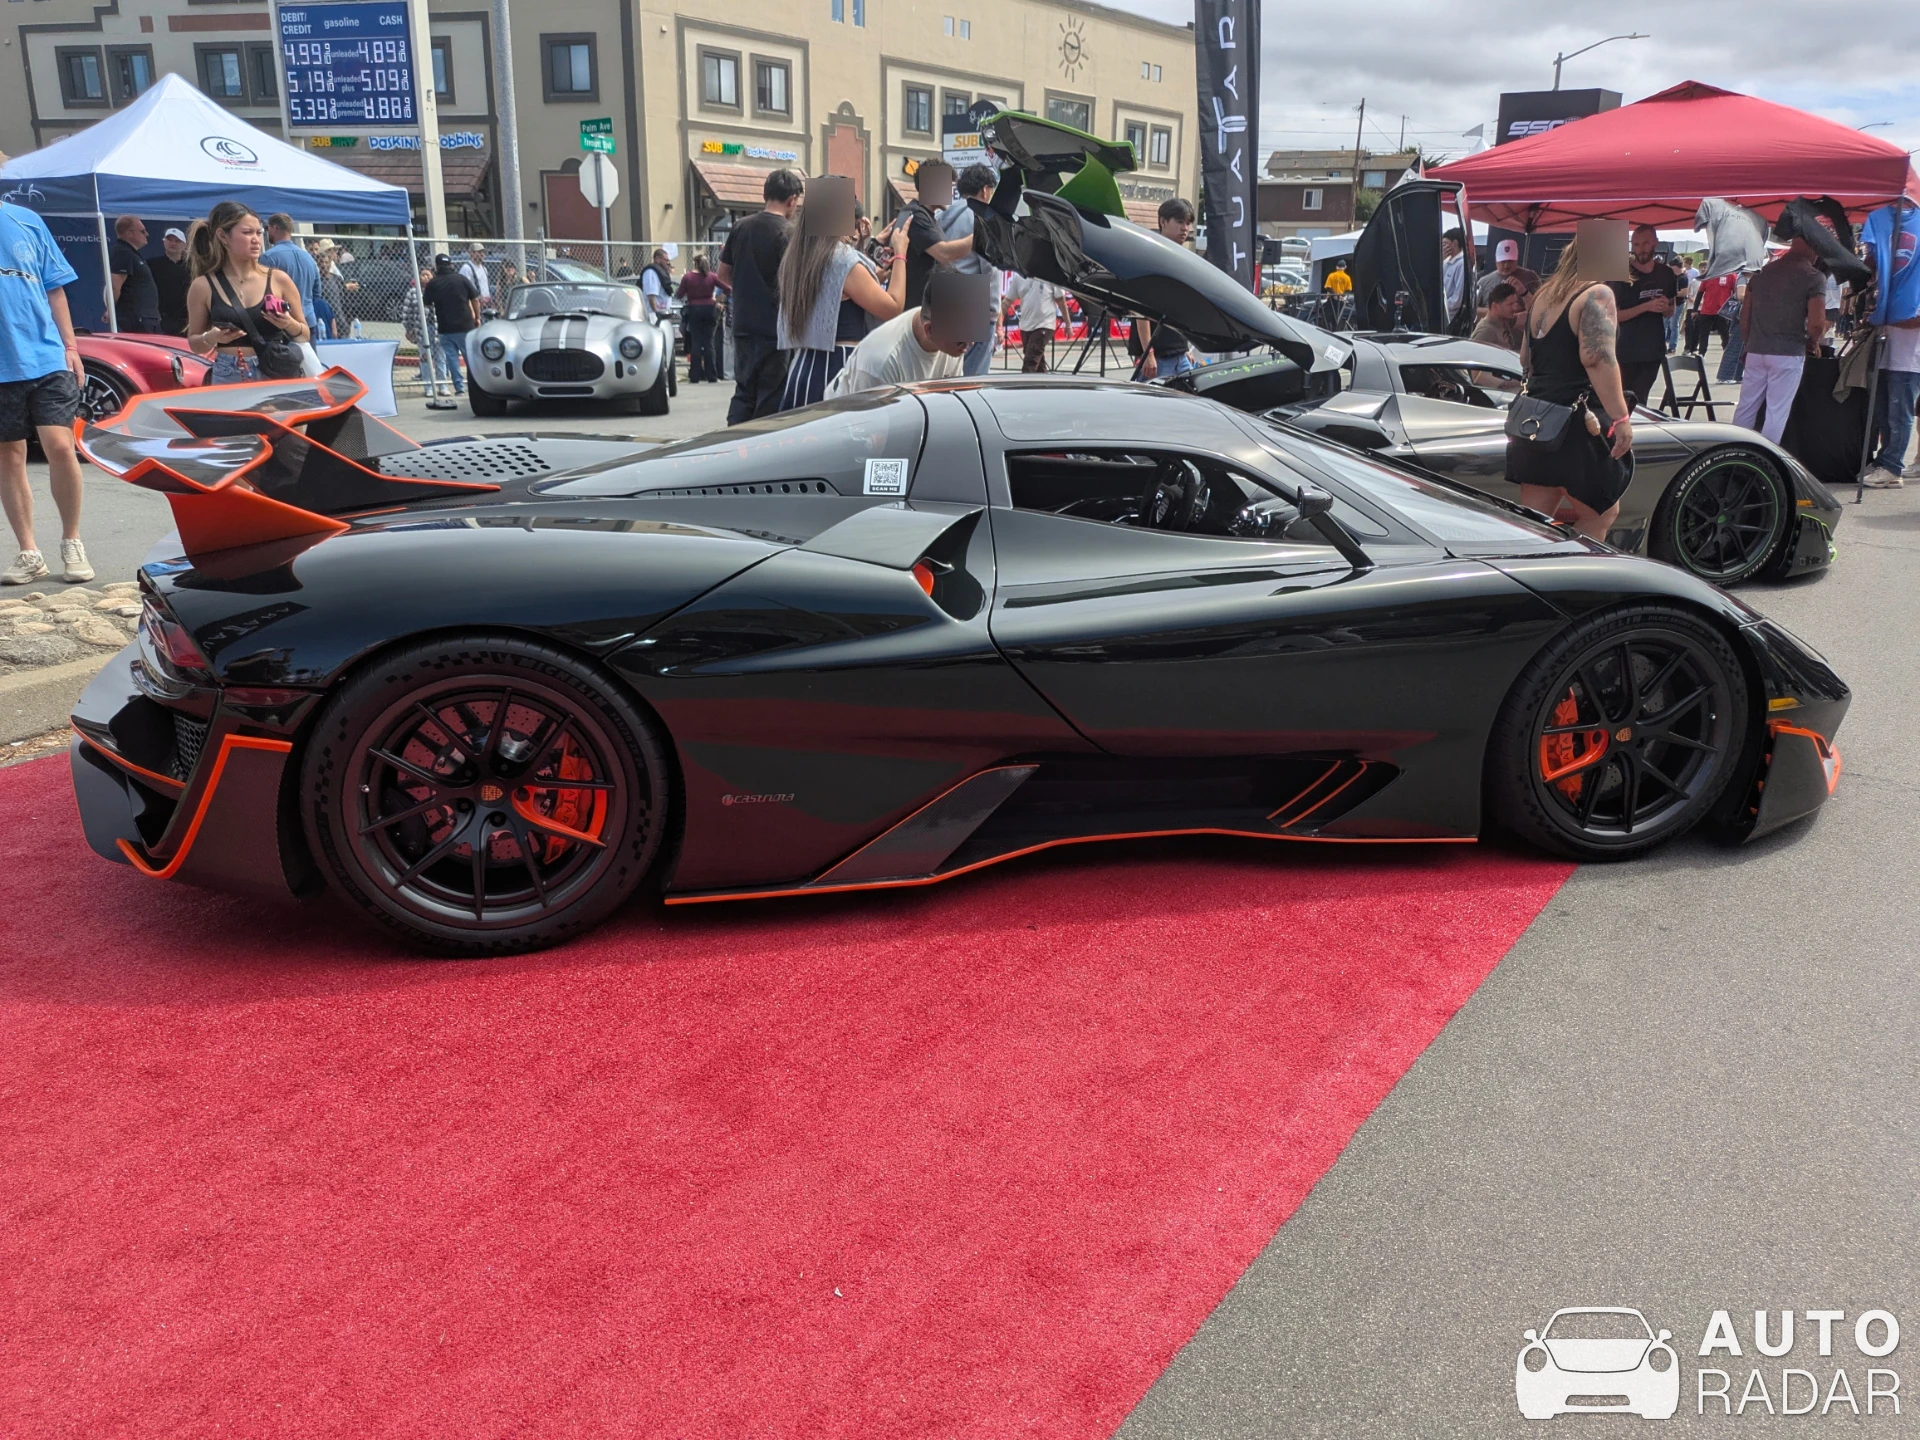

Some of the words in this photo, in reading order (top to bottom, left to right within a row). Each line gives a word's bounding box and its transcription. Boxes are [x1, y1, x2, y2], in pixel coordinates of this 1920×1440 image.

[281, 12, 307, 23] DEBIT/
[379, 15, 403, 26] CASH
[324, 17, 360, 30] gasoline
[282, 24, 312, 35] CREDIT
[330, 49, 360, 58] unleaded
[333, 74, 361, 83] unleaded
[341, 84, 355, 94] plus
[335, 100, 364, 108] unleaded
[337, 109, 365, 118] premium
[582, 123, 598, 133] Palm
[600, 121, 611, 131] Ave
[311, 136, 359, 147] SUBWAY
[438, 132, 484, 150] obbins
[1212, 0, 1248, 272] TUATAR
[702, 141, 744, 155] SUBWAY
[1639, 288, 1664, 299] SSC
[1680, 458, 1712, 491] MICHELIN
[517, 655, 609, 709] MICHELIN
